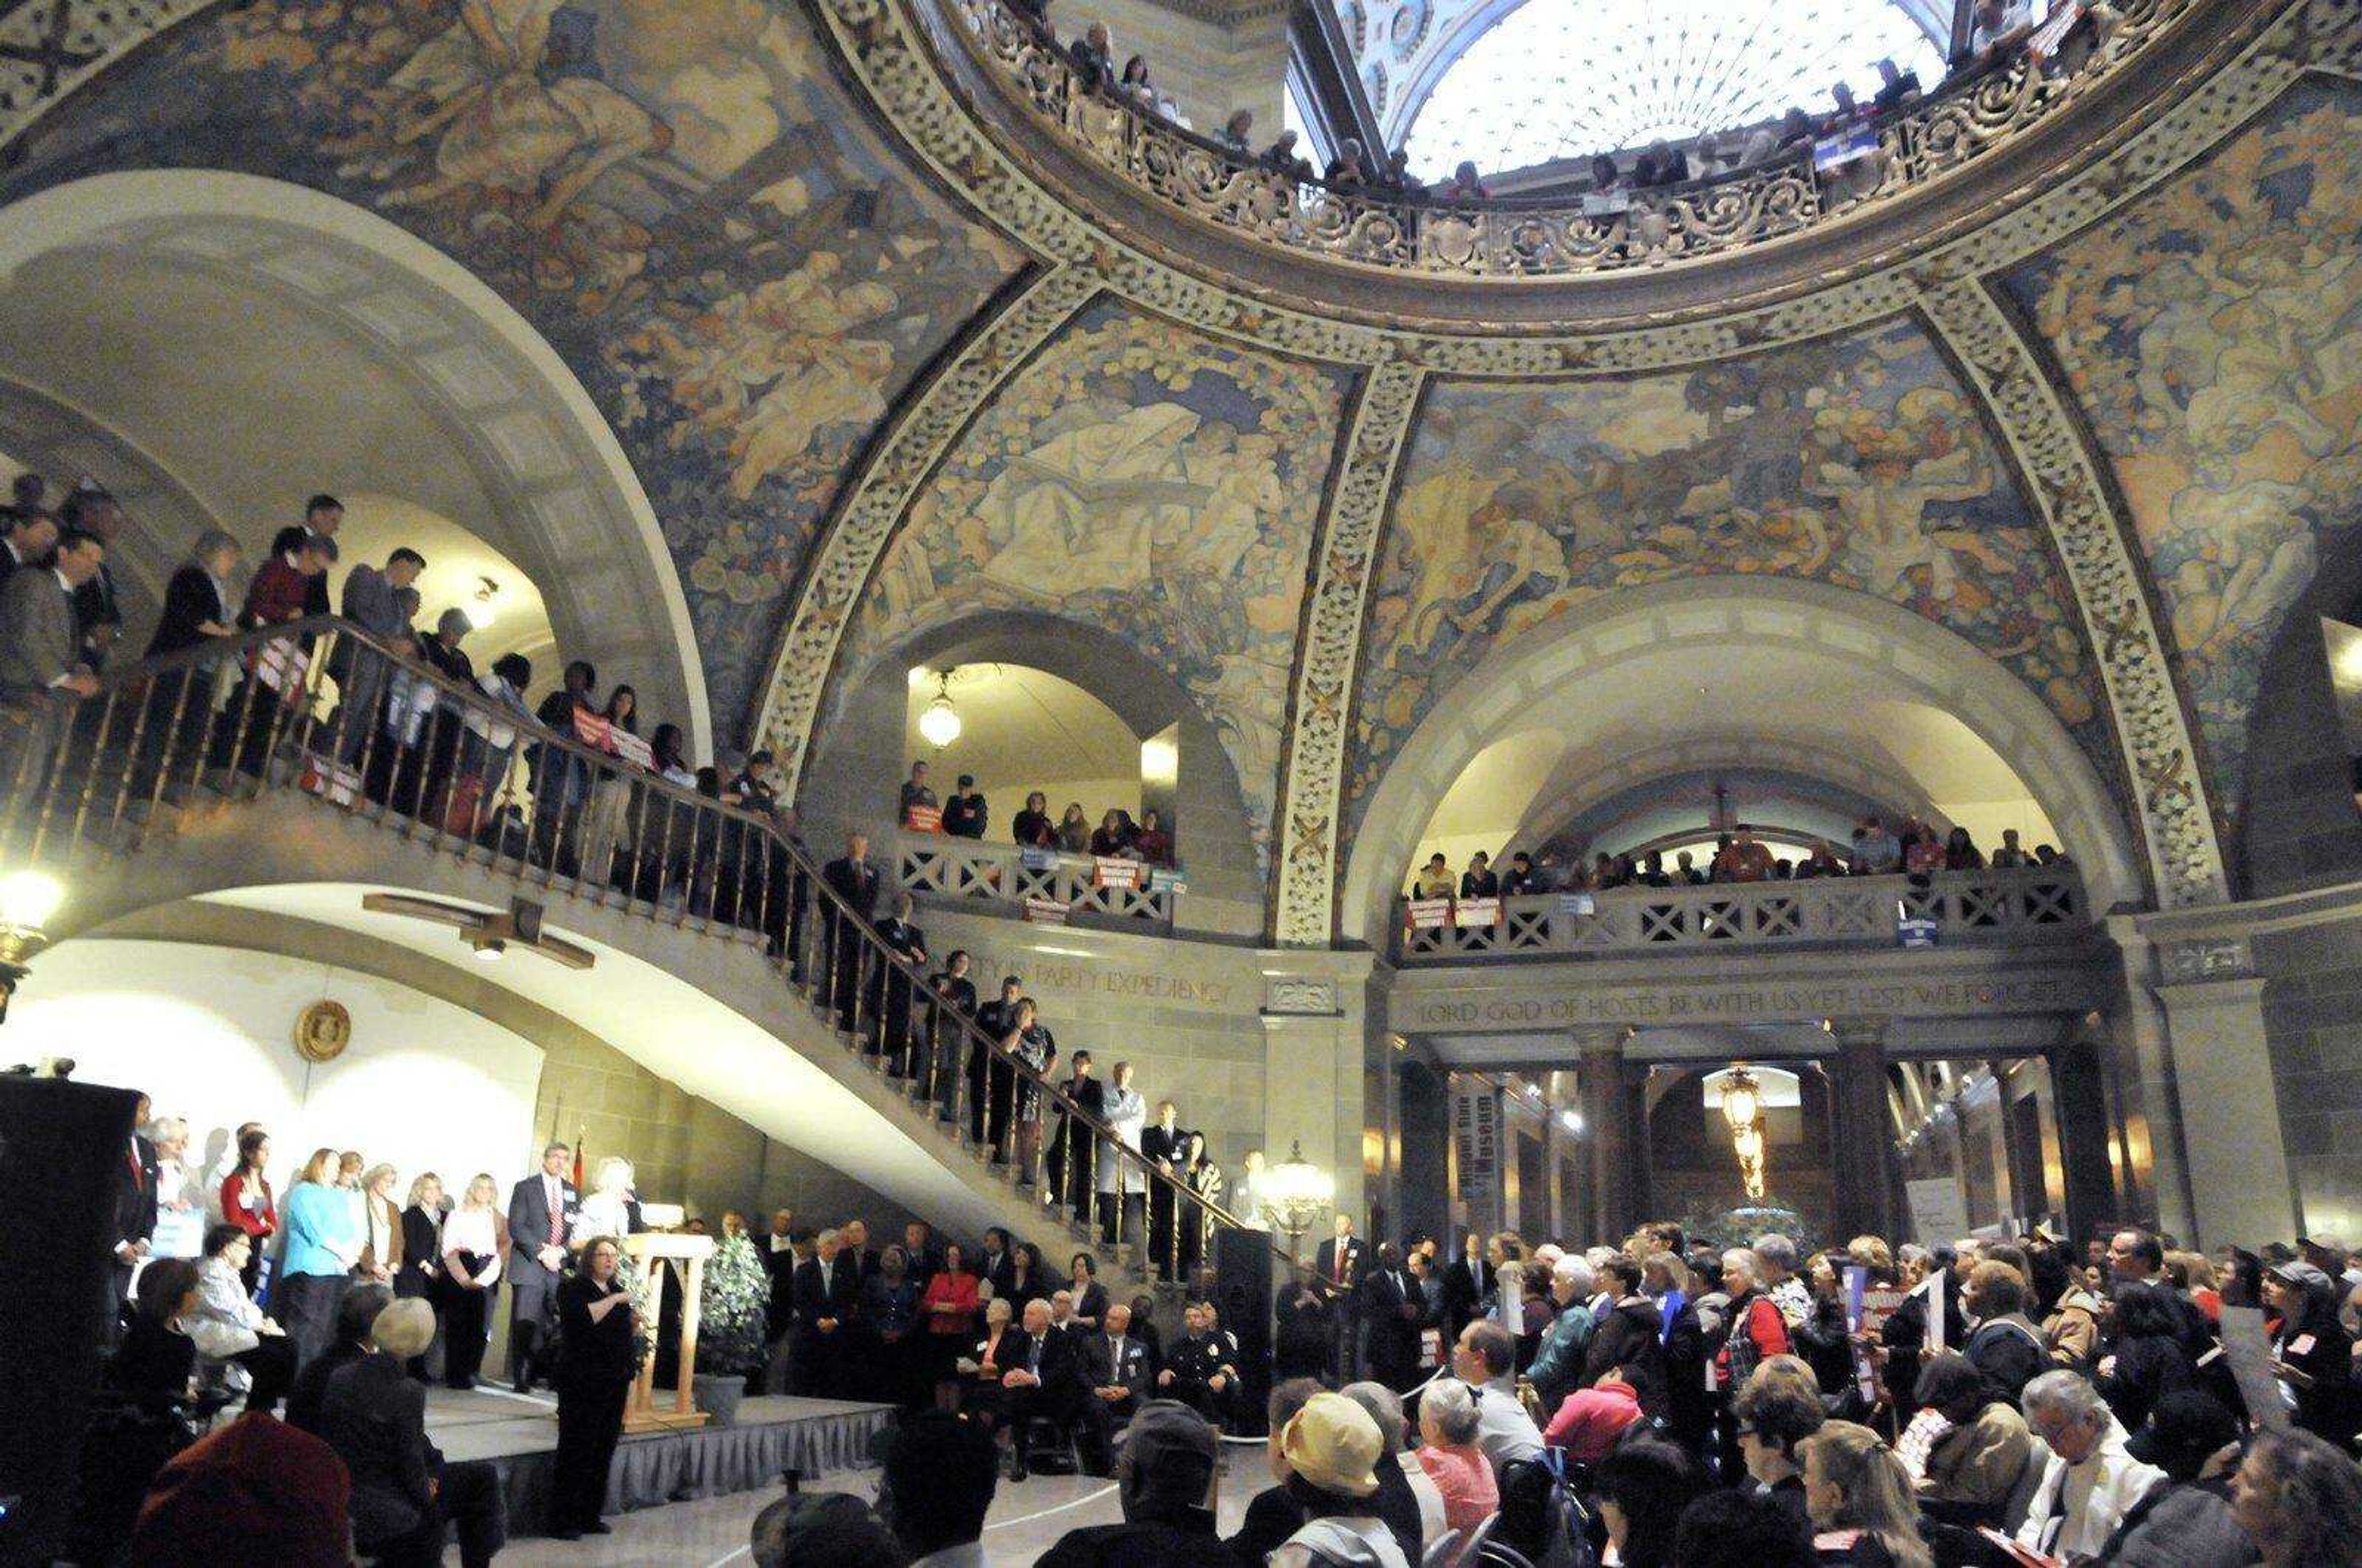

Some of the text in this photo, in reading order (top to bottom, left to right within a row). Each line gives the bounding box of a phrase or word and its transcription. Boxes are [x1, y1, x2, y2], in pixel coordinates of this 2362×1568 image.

[1035, 965, 1100, 990] PARTY
[1106, 971, 1232, 1005] EXPEDIENCY
[1420, 1002, 1478, 1023] LORD
[1487, 1000, 1541, 1021] GOD
[1549, 998, 1580, 1019] OF
[1588, 995, 1660, 1017] HOSTS
[1699, 992, 1763, 1013] WITH
[1772, 991, 1802, 1011] US
[1912, 984, 1957, 1005] WE
